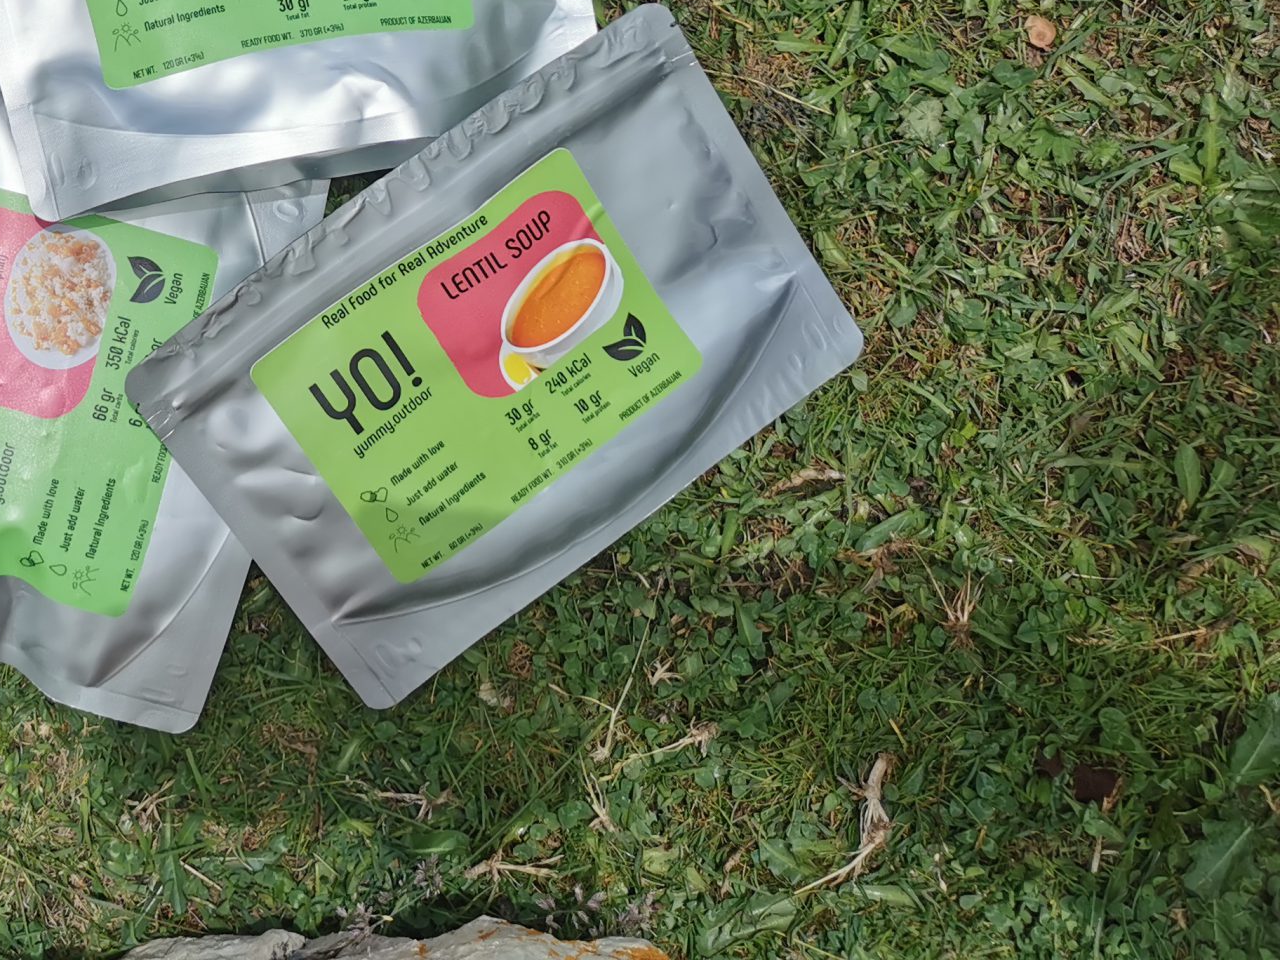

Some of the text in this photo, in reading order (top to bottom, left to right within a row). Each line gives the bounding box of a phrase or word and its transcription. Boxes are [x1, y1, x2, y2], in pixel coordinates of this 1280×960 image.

[143, 4, 226, 32] Natural Ingredients
[240, 36, 263, 49] READY
[263, 33, 281, 44] FOOD
[379, 16, 408, 27] PRODUCT
[407, 15, 416, 25] OF
[321, 215, 488, 329] Real Food for Real Adventure
[440, 210, 551, 300] LENTIL SOUP
[163, 272, 184, 305] Vegan
[92, 315, 132, 422] 66 gr 350 kCal
[310, 332, 422, 434] YO!
[504, 352, 592, 426] 30 gr 240 kCal
[627, 352, 660, 378] Vegan
[353, 387, 432, 459] yummy.outdoor
[527, 390, 602, 451] 8 gr 10 gr
[618, 399, 644, 421] PRODUCT
[390, 440, 445, 487] Made with love
[406, 461, 458, 507] Just add water
[32, 478, 60, 546] Made with love
[59, 486, 86, 553] Just add water
[85, 478, 116, 560] Natural Ingredients
[418, 472, 487, 526] Natural Ingredients
